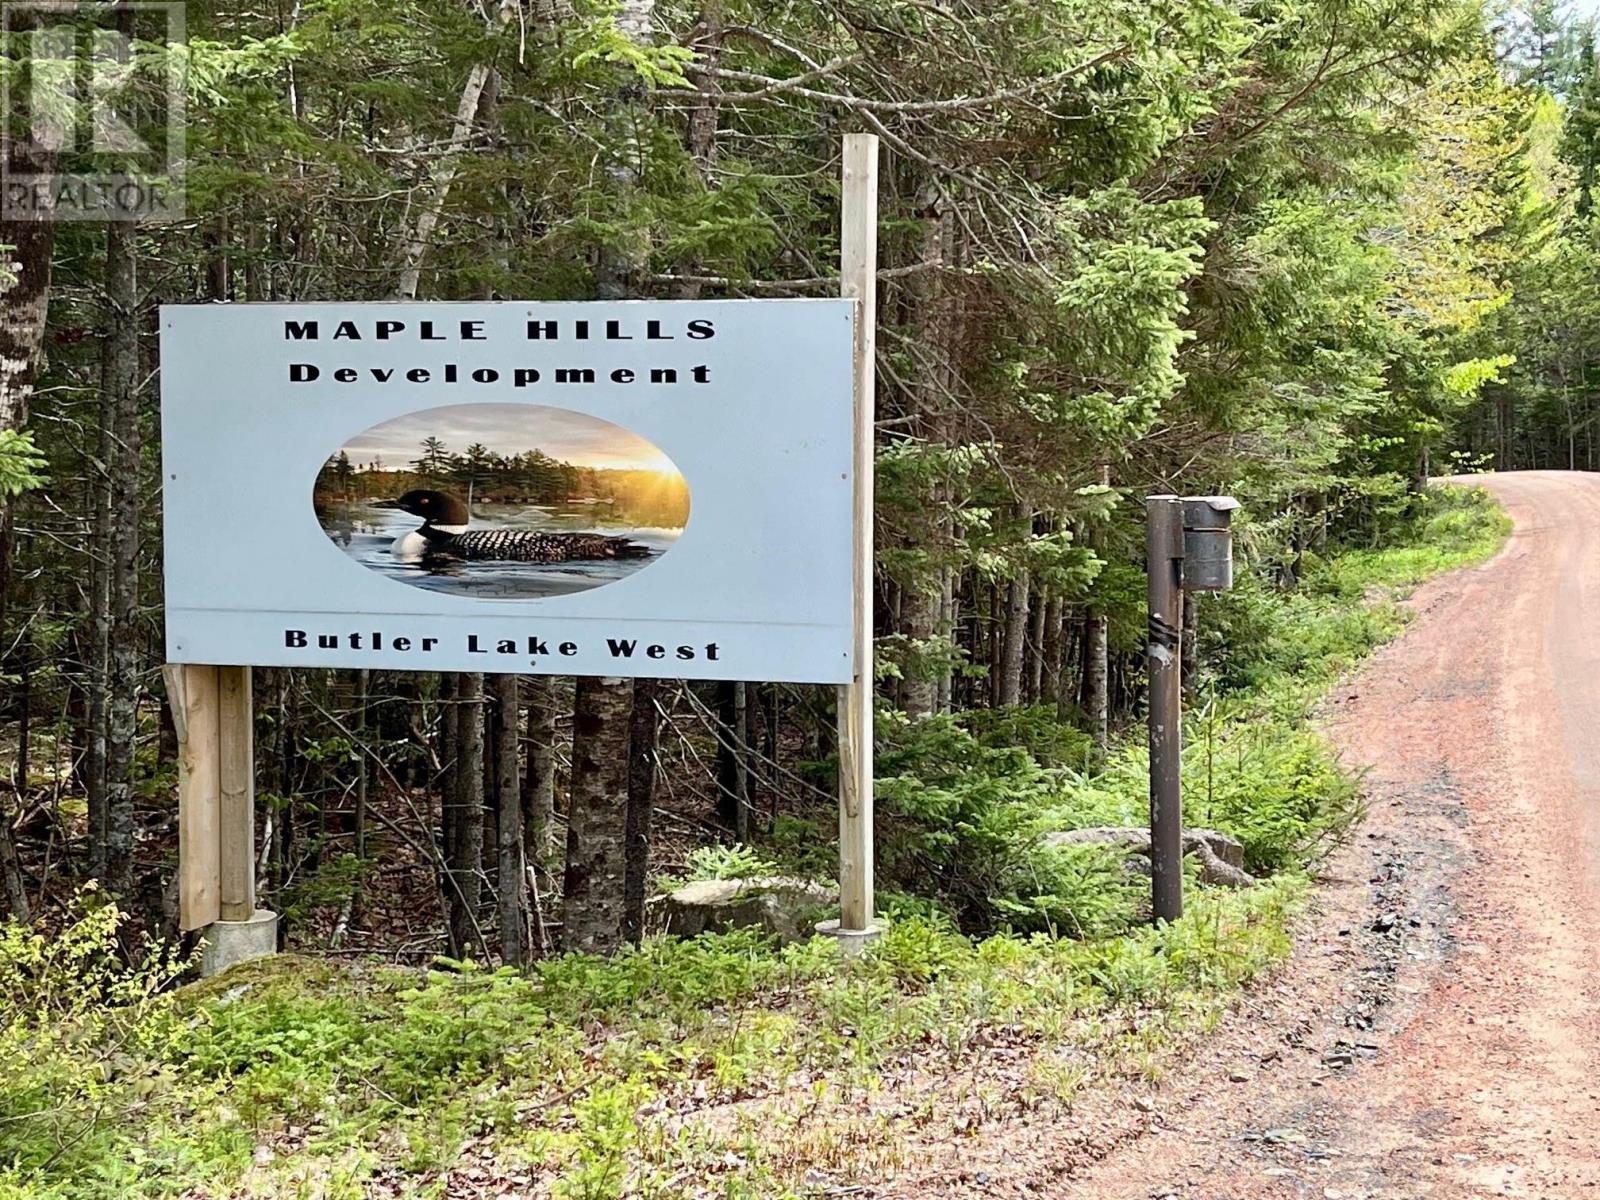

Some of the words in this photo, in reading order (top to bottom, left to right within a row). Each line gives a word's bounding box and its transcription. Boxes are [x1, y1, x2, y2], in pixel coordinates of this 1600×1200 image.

[284, 320, 487, 341] MAPLE
[527, 319, 716, 340] HILLS
[289, 363, 711, 388] Development
[285, 630, 439, 653] Butler
[467, 634, 578, 656] Lake
[606, 638, 720, 662] West
